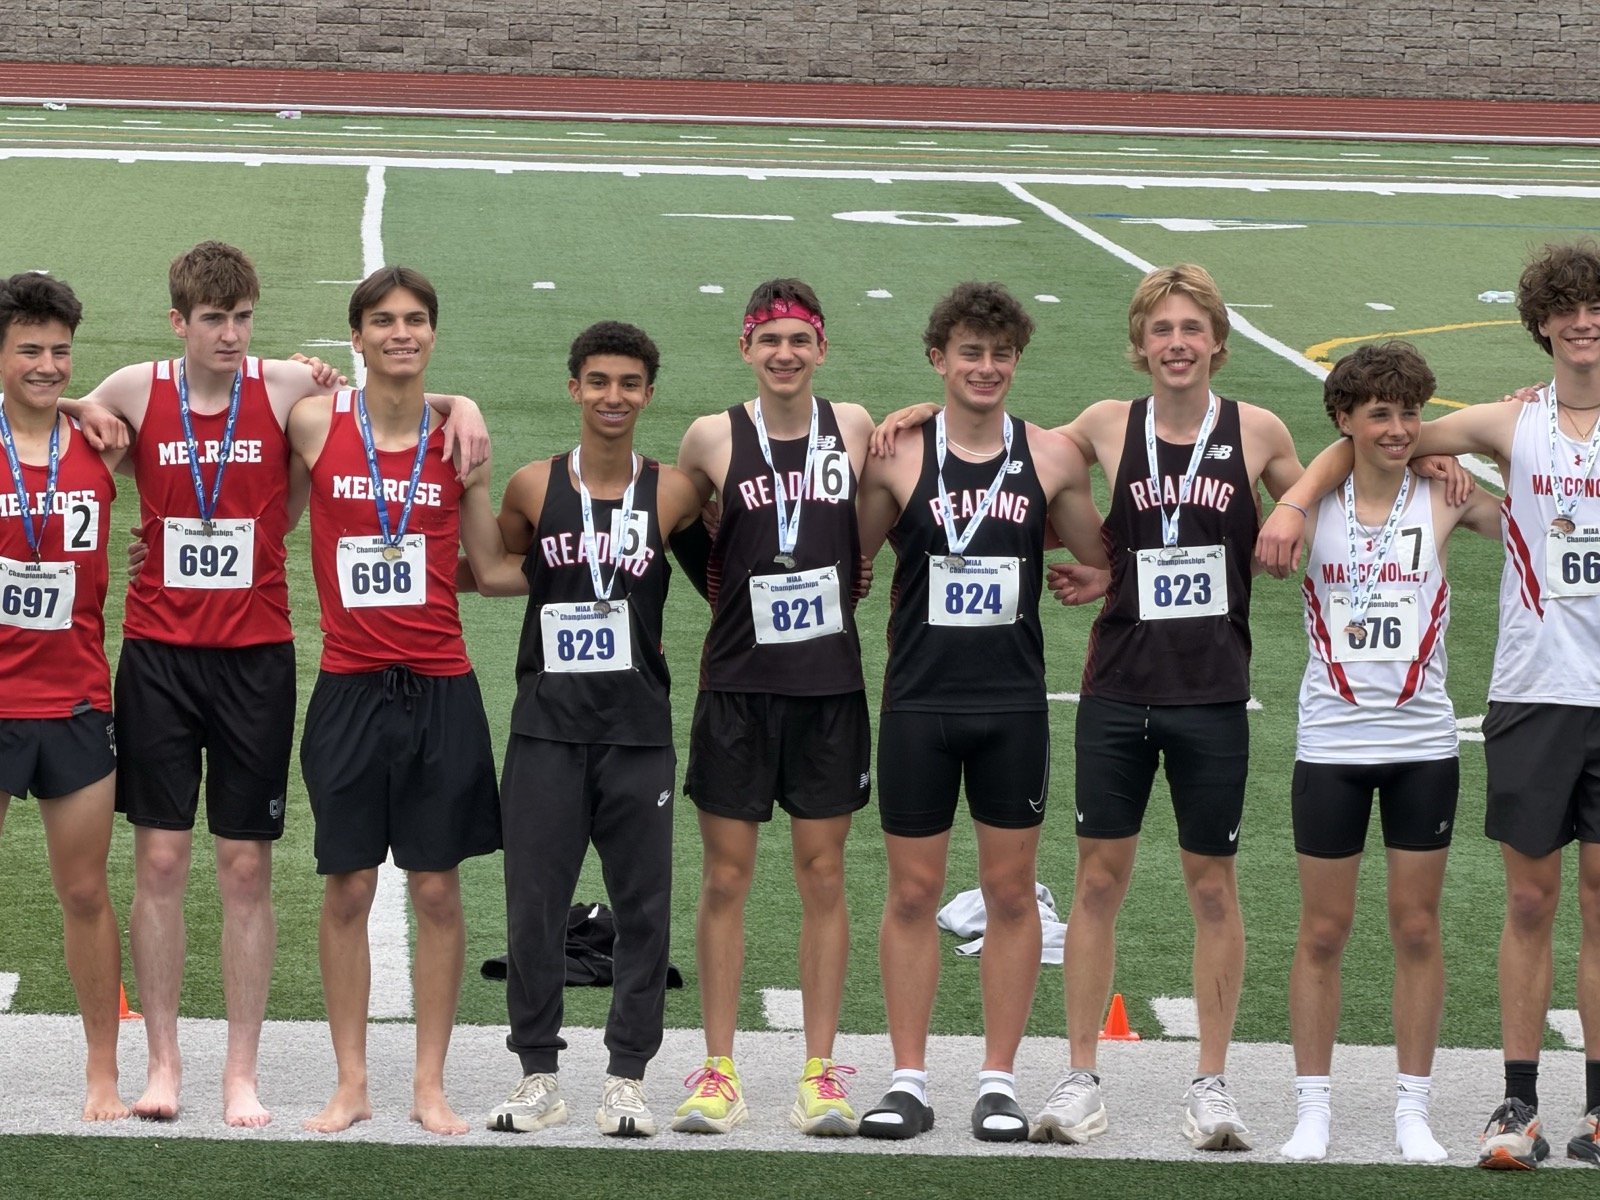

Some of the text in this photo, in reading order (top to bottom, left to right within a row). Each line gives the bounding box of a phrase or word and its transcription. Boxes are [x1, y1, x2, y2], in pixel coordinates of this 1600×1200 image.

[332, 475, 442, 507] MELROSE
[738, 471, 839, 511] REDI
[822, 453, 843, 496] 6
[1532, 474, 1600, 498] MACON
[929, 488, 1030, 526] READING
[1129, 475, 1235, 513] READING
[71, 504, 91, 548] 2
[184, 529, 234, 537] Champnships
[620, 512, 640, 557] 5
[179, 544, 239, 577] 692
[356, 546, 405, 554] Champiops
[541, 531, 655, 577] READG
[965, 559, 982, 567] MIAA
[1156, 557, 1206, 566] Championships
[1401, 526, 1423, 571] 7
[8, 569, 57, 580] Championships
[351, 560, 411, 595] 698
[770, 581, 819, 593] Championships
[786, 575, 802, 583] MIAA
[949, 566, 999, 575] Championships
[2, 584, 60, 619] 697
[945, 582, 1003, 615] 824
[1153, 572, 1212, 608] 823
[560, 613, 608, 621] Championships
[771, 594, 825, 632] 821
[557, 627, 615, 661] 829
[1348, 616, 1402, 650] 676
